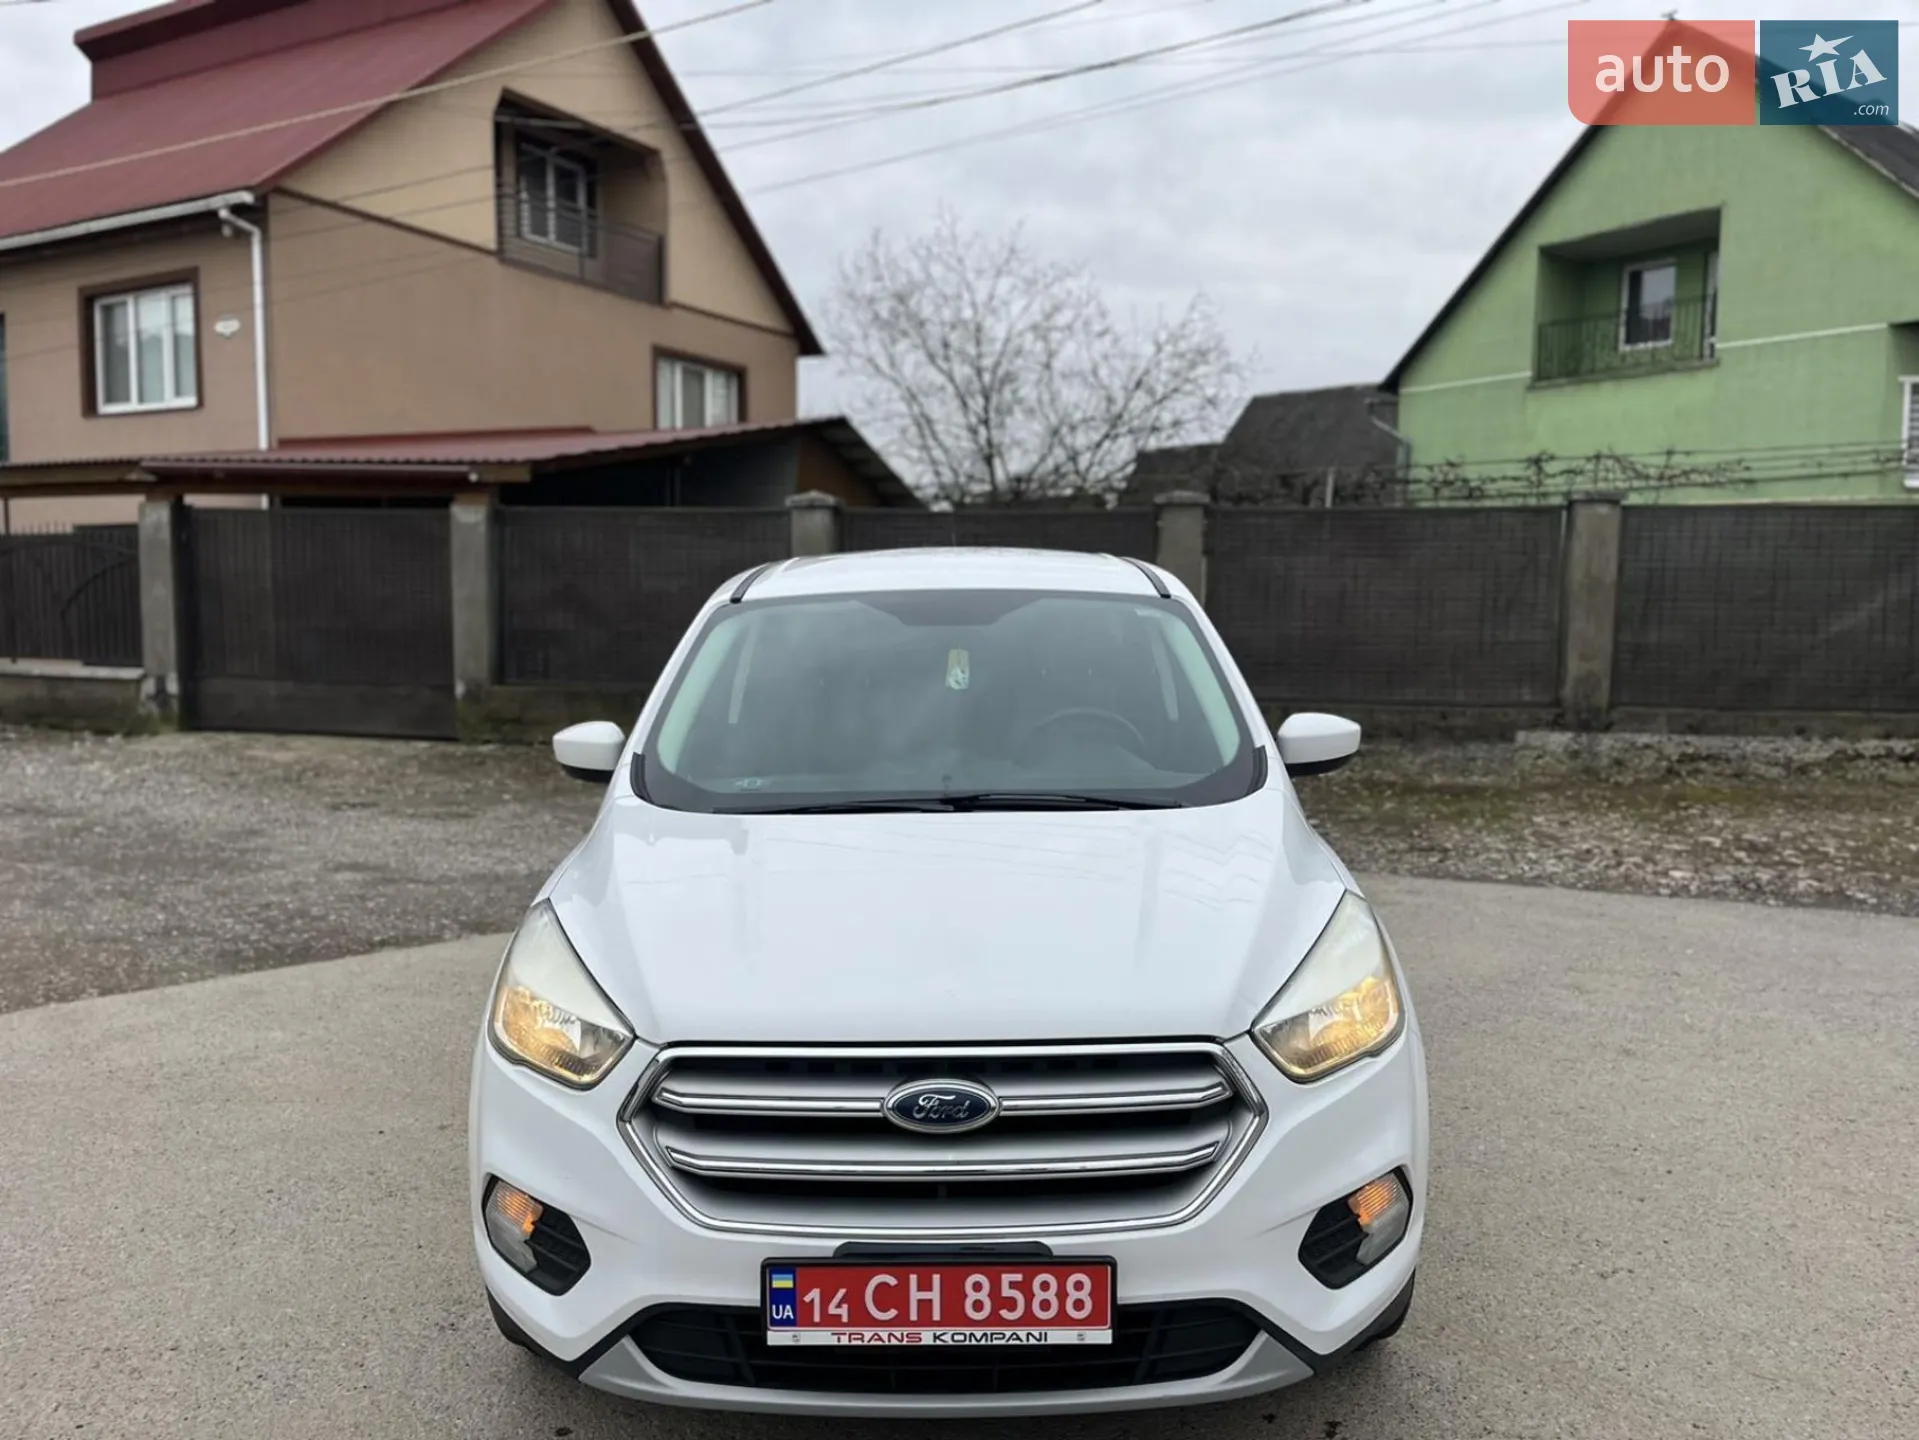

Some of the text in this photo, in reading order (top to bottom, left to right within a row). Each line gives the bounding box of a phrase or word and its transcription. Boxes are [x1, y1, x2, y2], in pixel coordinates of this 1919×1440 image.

[912, 1093, 970, 1119] Ford
[803, 1273, 1093, 1323] 14 CH 8588
[772, 1304, 794, 1320] UA
[831, 1331, 1048, 1343] TRANS KOMPANI
